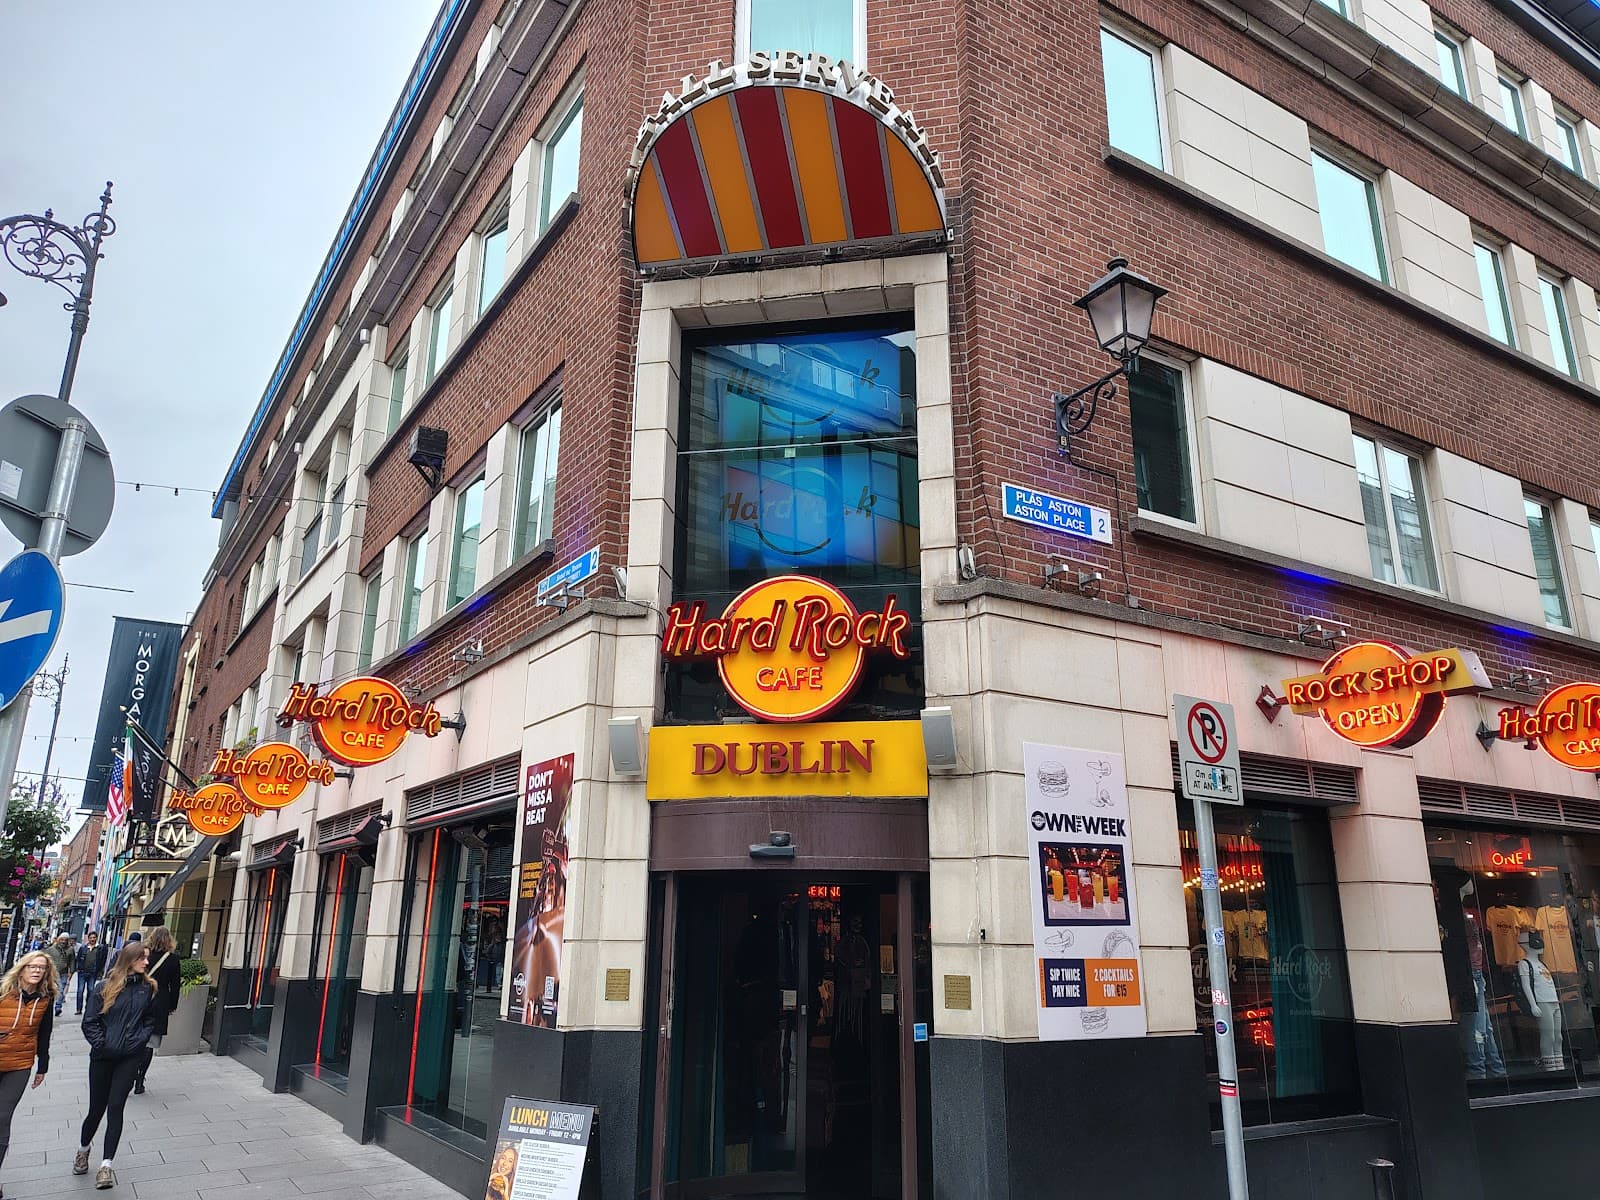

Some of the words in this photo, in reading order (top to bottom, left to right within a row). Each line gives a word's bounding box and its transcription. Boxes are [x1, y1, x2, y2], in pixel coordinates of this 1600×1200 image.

[656, 59, 737, 125] ALL
[747, 49, 895, 115] SERVE
[1014, 504, 1048, 522] ASTON
[1053, 515, 1085, 531] PLACE
[1048, 500, 1081, 517] ASTON
[1098, 518, 1105, 534] 2
[592, 551, 597, 570] 2
[662, 599, 786, 660] Hard
[791, 593, 912, 662] Rock
[756, 666, 823, 691] CAFE
[1289, 672, 1369, 704] ROCK
[1369, 657, 1455, 691] SHOP
[283, 683, 369, 721] Hard
[367, 692, 441, 738] Rock
[1339, 702, 1402, 730] OPEN
[1498, 699, 1579, 740] Hard
[342, 732, 385, 747] CAFE
[212, 749, 276, 776] Hard
[275, 754, 332, 786] Rock
[692, 739, 875, 776] DUBLIN
[256, 783, 290, 795] CAFE
[529, 769, 554, 790] DON'T
[167, 788, 218, 810] Hard
[217, 792, 261, 818] Roc
[527, 789, 545, 808] MISS
[545, 788, 553, 804] A
[202, 815, 230, 825] CAFE
[525, 807, 546, 825] BEAT
[1031, 810, 1077, 833] OWN
[1082, 815, 1126, 837] WEEK
[165, 823, 188, 846] M
[1049, 968, 1060, 981] SIP
[1061, 968, 1080, 981] TWICE
[1094, 969, 1099, 982] 2
[1100, 969, 1134, 982] COCKTAILS
[1052, 985, 1065, 998] PAY
[1065, 985, 1080, 998] NICE
[1103, 984, 1115, 998] FOR
[1116, 984, 1127, 998] €15
[1197, 986, 1212, 996] CAF
[509, 1106, 549, 1127] LUNCH
[549, 1111, 585, 1132] MENU
